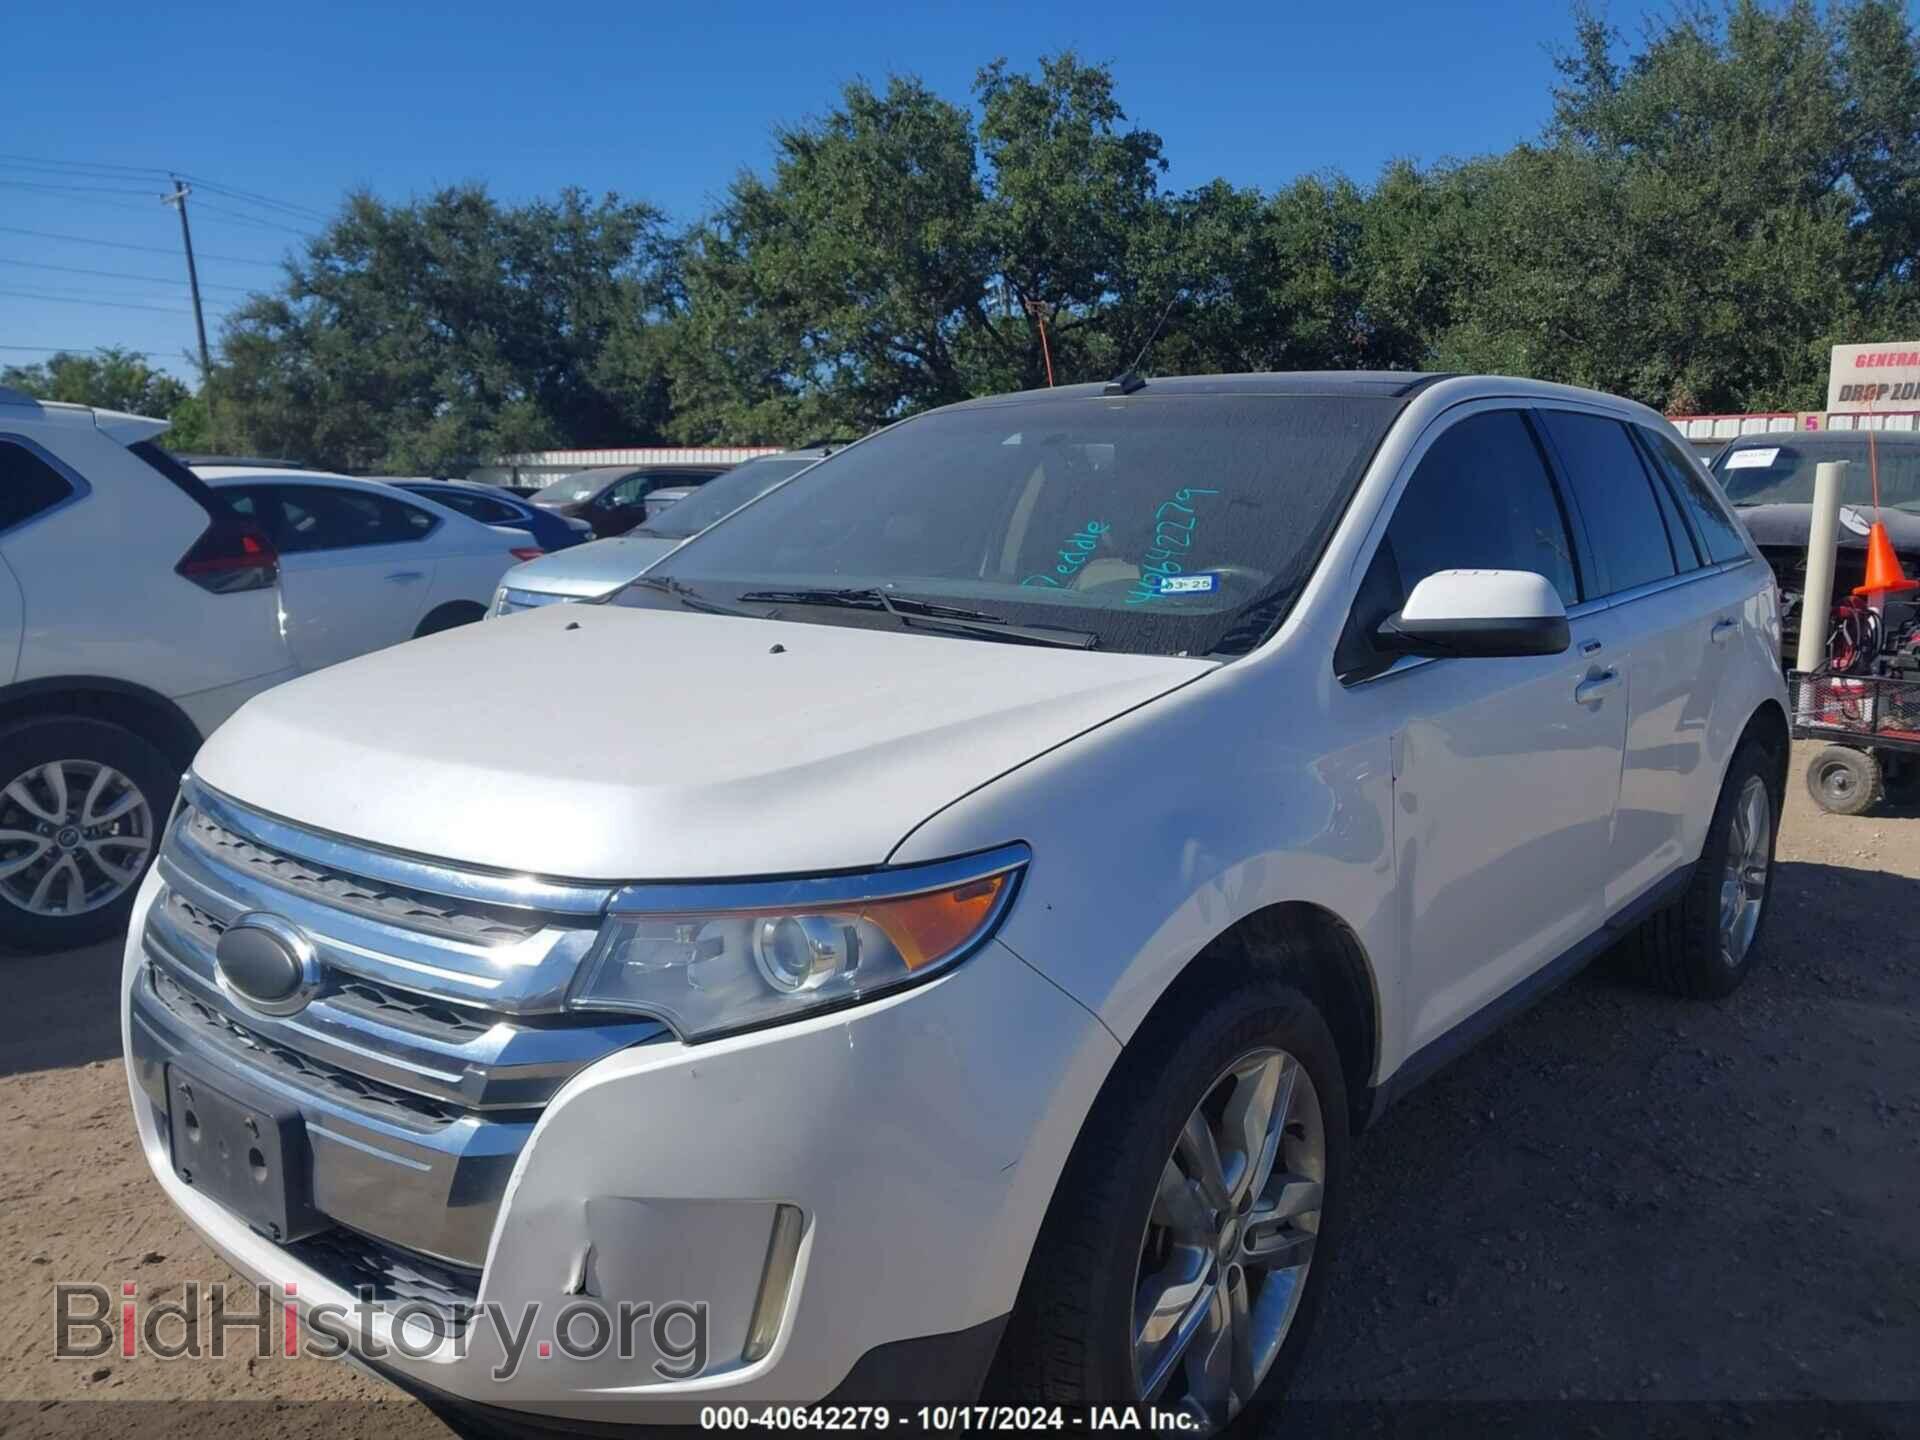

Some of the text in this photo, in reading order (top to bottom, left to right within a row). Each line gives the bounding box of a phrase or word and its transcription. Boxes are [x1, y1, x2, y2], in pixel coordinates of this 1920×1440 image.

[1855, 352, 1920, 368] GENERA
[1838, 384, 1890, 401] DROP
[1805, 415, 1818, 431] 5
[1123, 488, 1220, 604] 40642279
